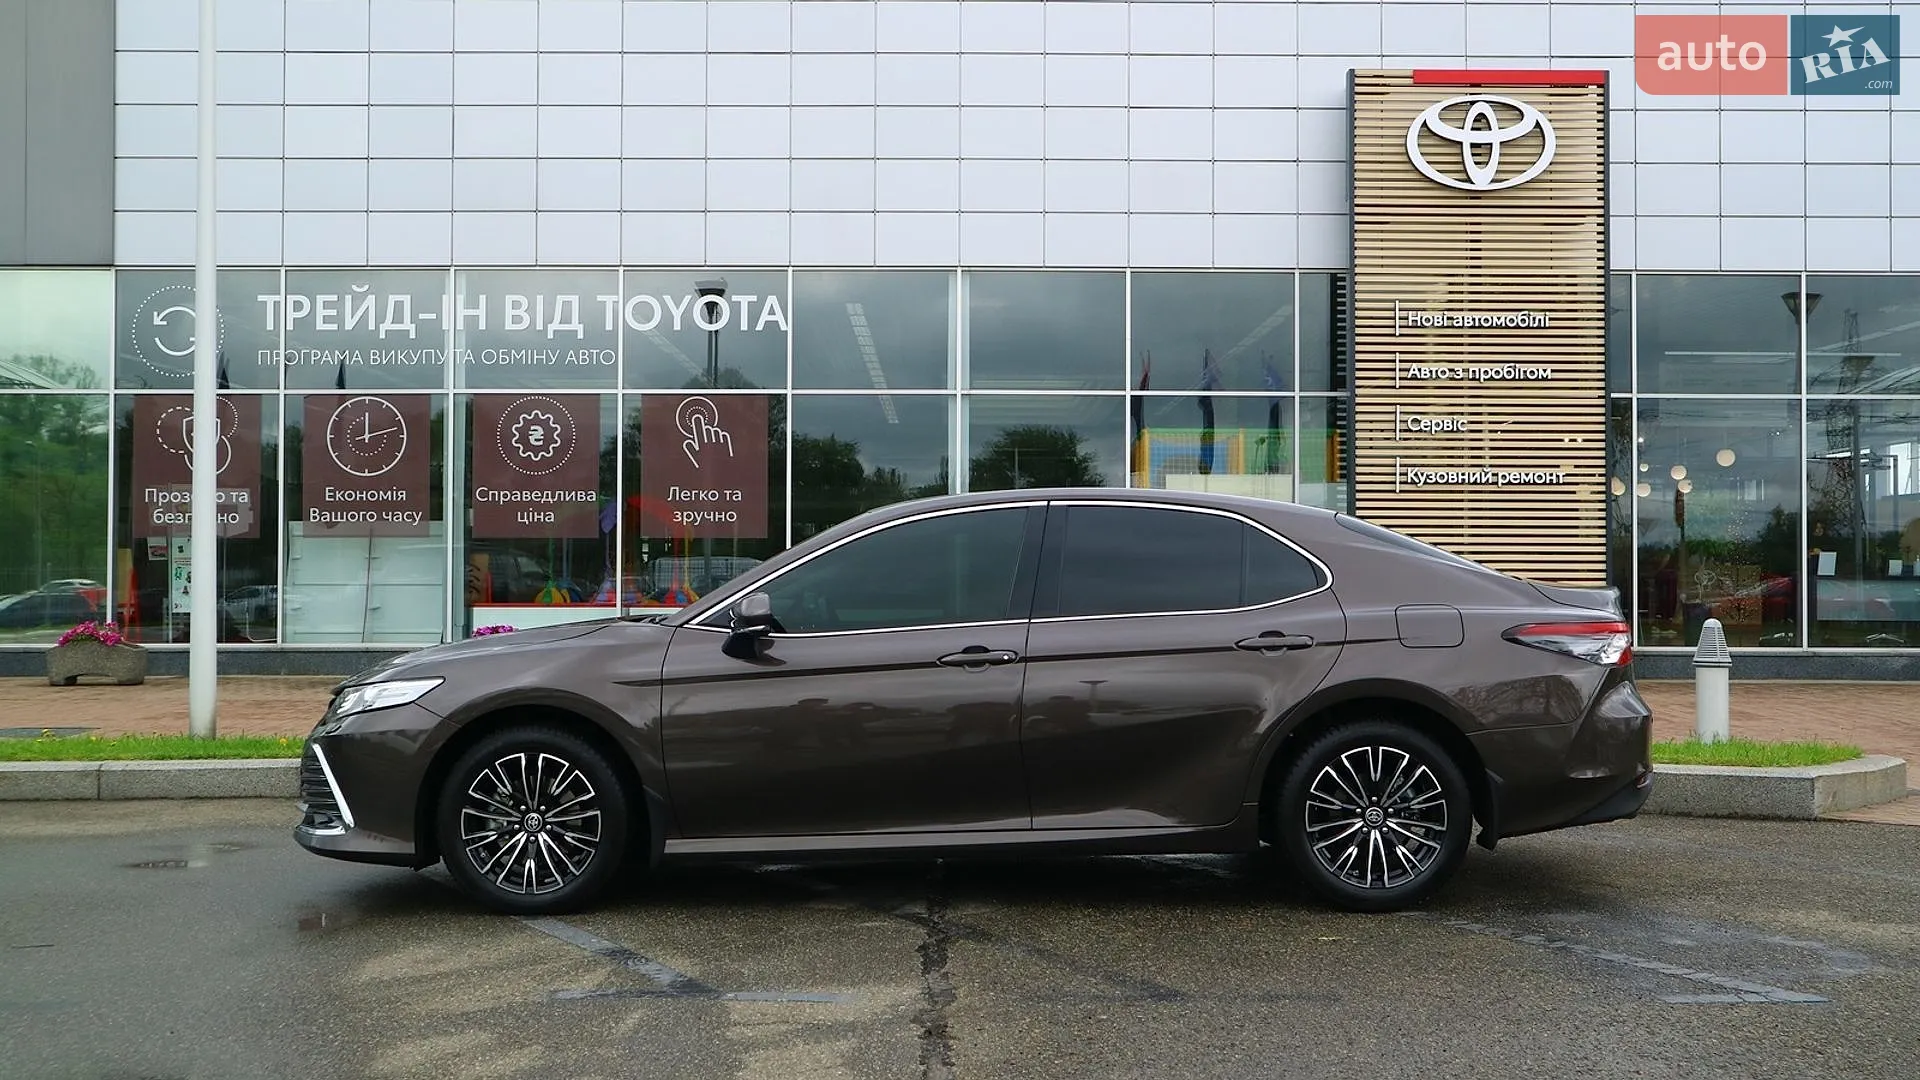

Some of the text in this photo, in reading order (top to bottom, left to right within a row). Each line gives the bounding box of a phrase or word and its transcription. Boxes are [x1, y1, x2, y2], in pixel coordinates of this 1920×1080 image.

[257, 284, 788, 339] ТРЕЙД-ІН ВІД TOYOTA
[1407, 311, 1550, 328] Нові автомобілі
[257, 348, 616, 366] ПРОГРАМА ВИКУПУ ТА ОБМІНУ АВТО
[1407, 363, 1552, 383] Авто з пробігом
[1407, 416, 1468, 434] Сервіс
[1407, 467, 1566, 488] Кузовний ремонт
[145, 488, 249, 506] Прозо та
[325, 487, 406, 502] Економія
[475, 487, 597, 504] Справедлива
[667, 487, 742, 503] Легко та
[153, 508, 240, 524] безпно
[309, 508, 422, 527] Вашого часу
[517, 508, 555, 525] ціна
[673, 511, 737, 527] зручно
